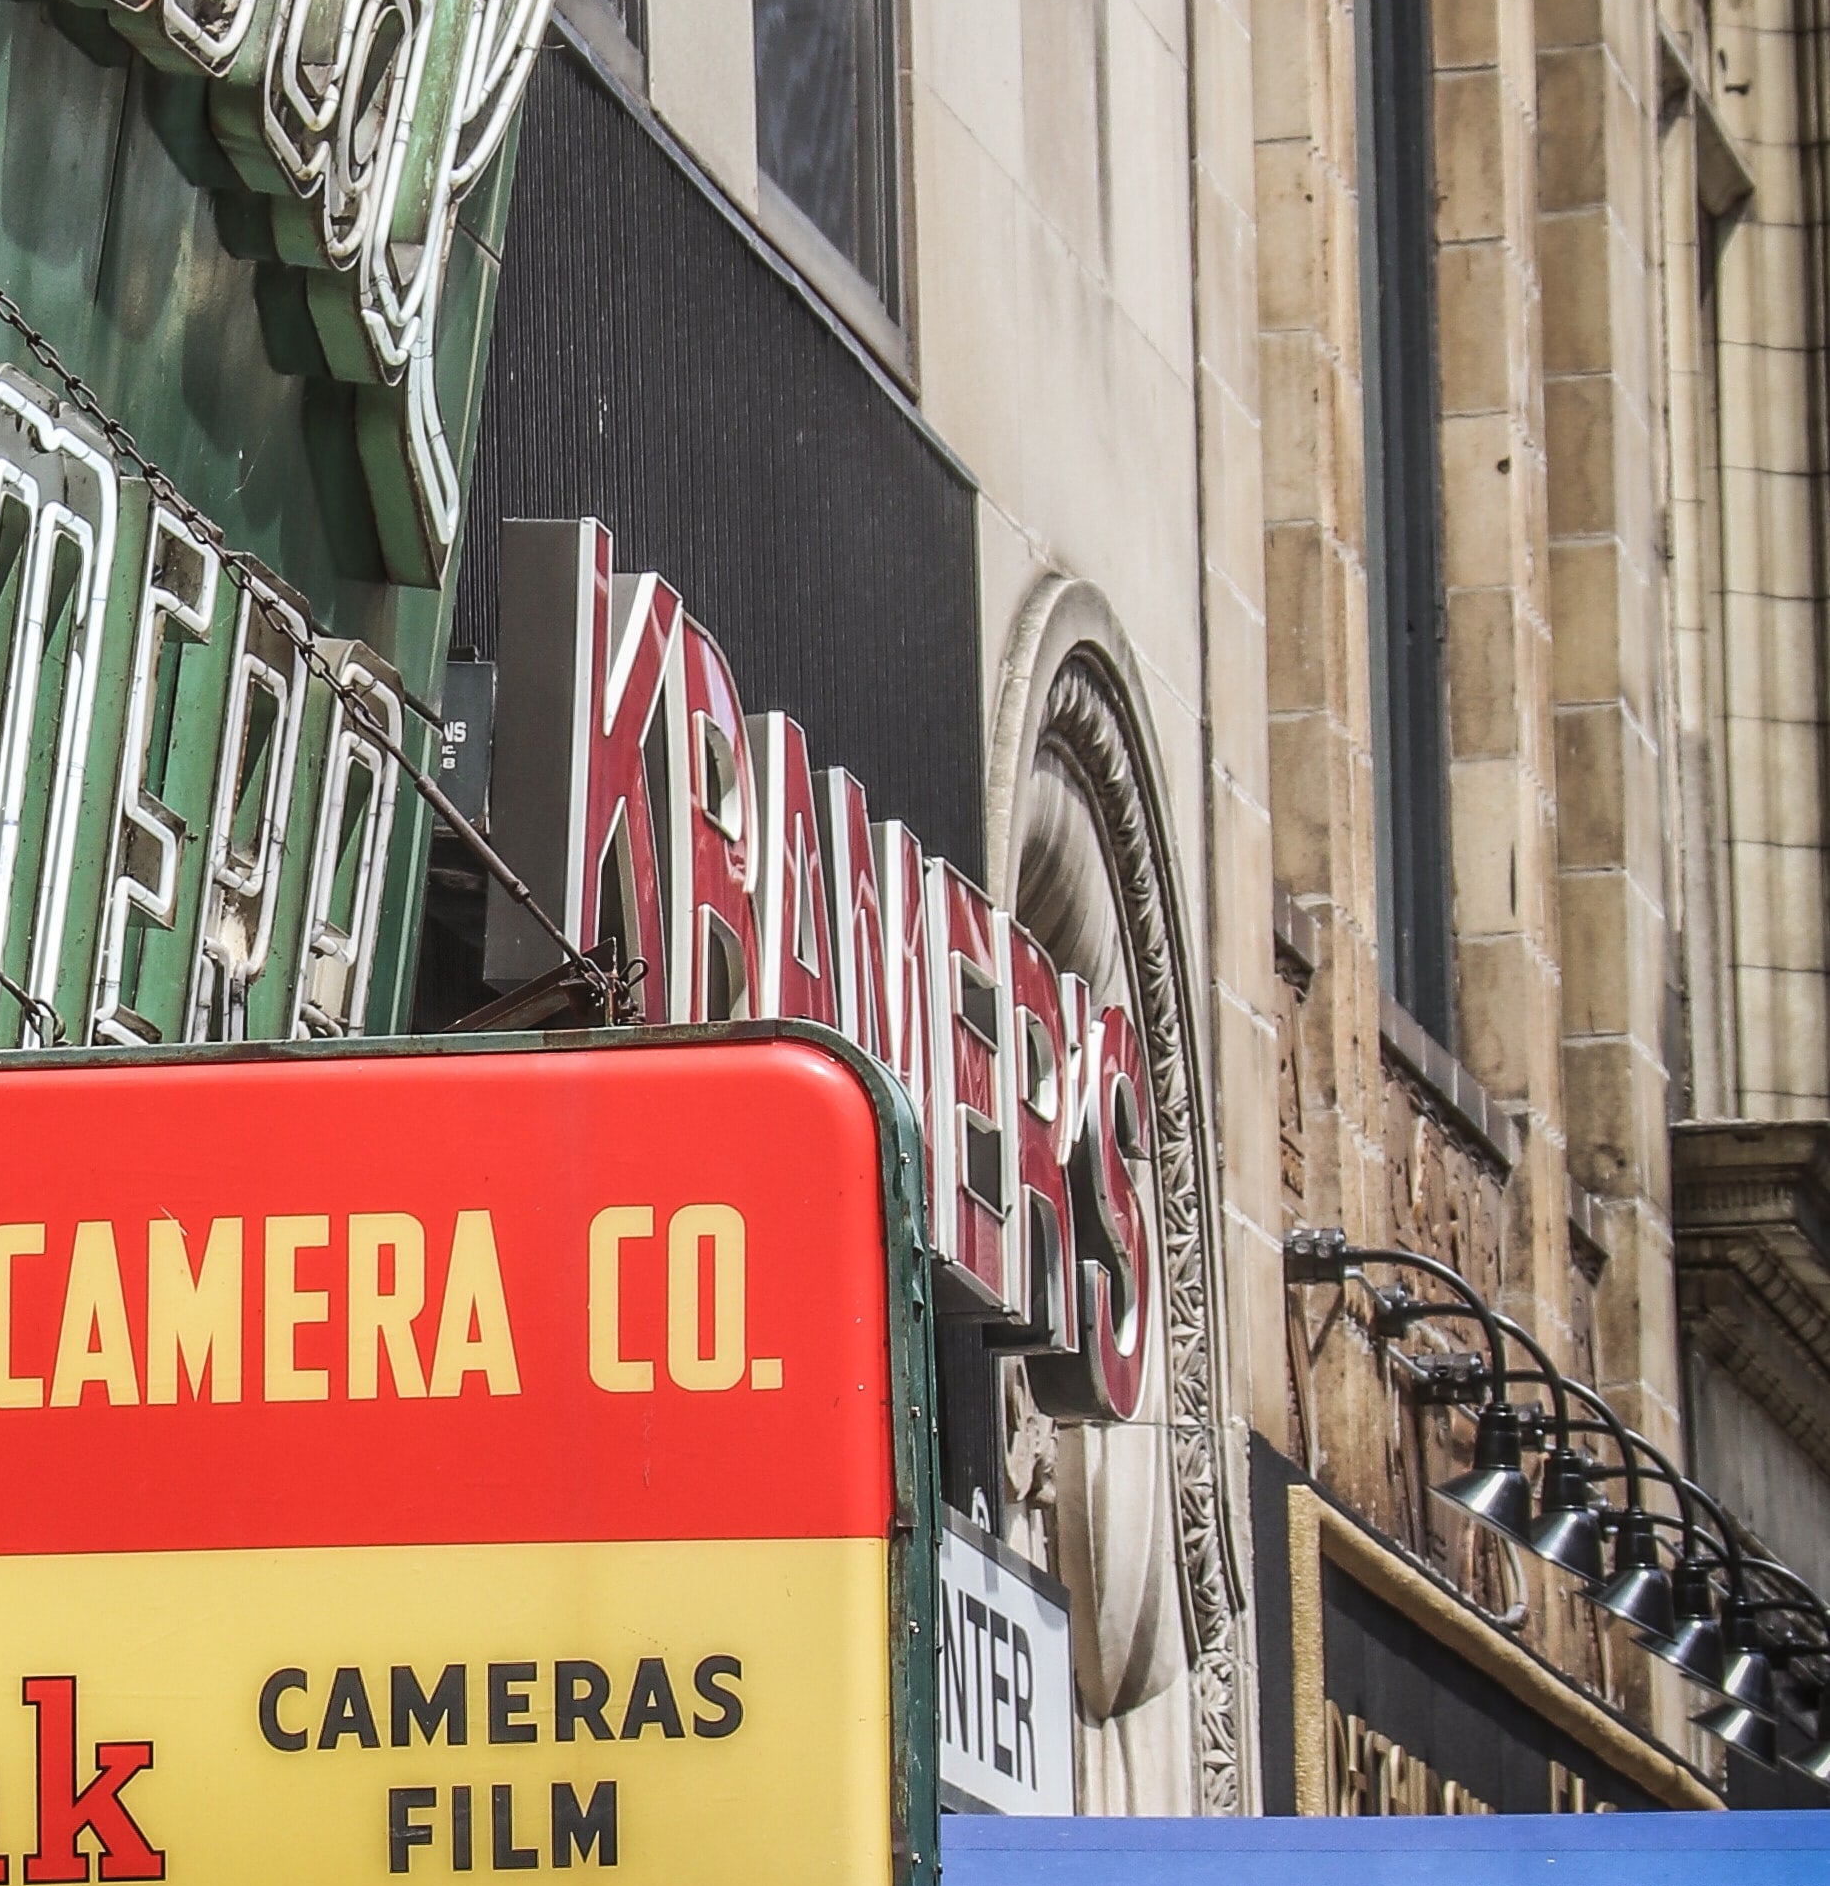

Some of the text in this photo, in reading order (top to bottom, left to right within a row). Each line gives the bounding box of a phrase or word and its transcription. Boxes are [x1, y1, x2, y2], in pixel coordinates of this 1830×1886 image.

[570, 517, 1152, 1422] KRAMER'S
[587, 1203, 783, 1394] CO.
[258, 1655, 745, 1755] CAMERAS
[388, 1779, 621, 1876] FILM
